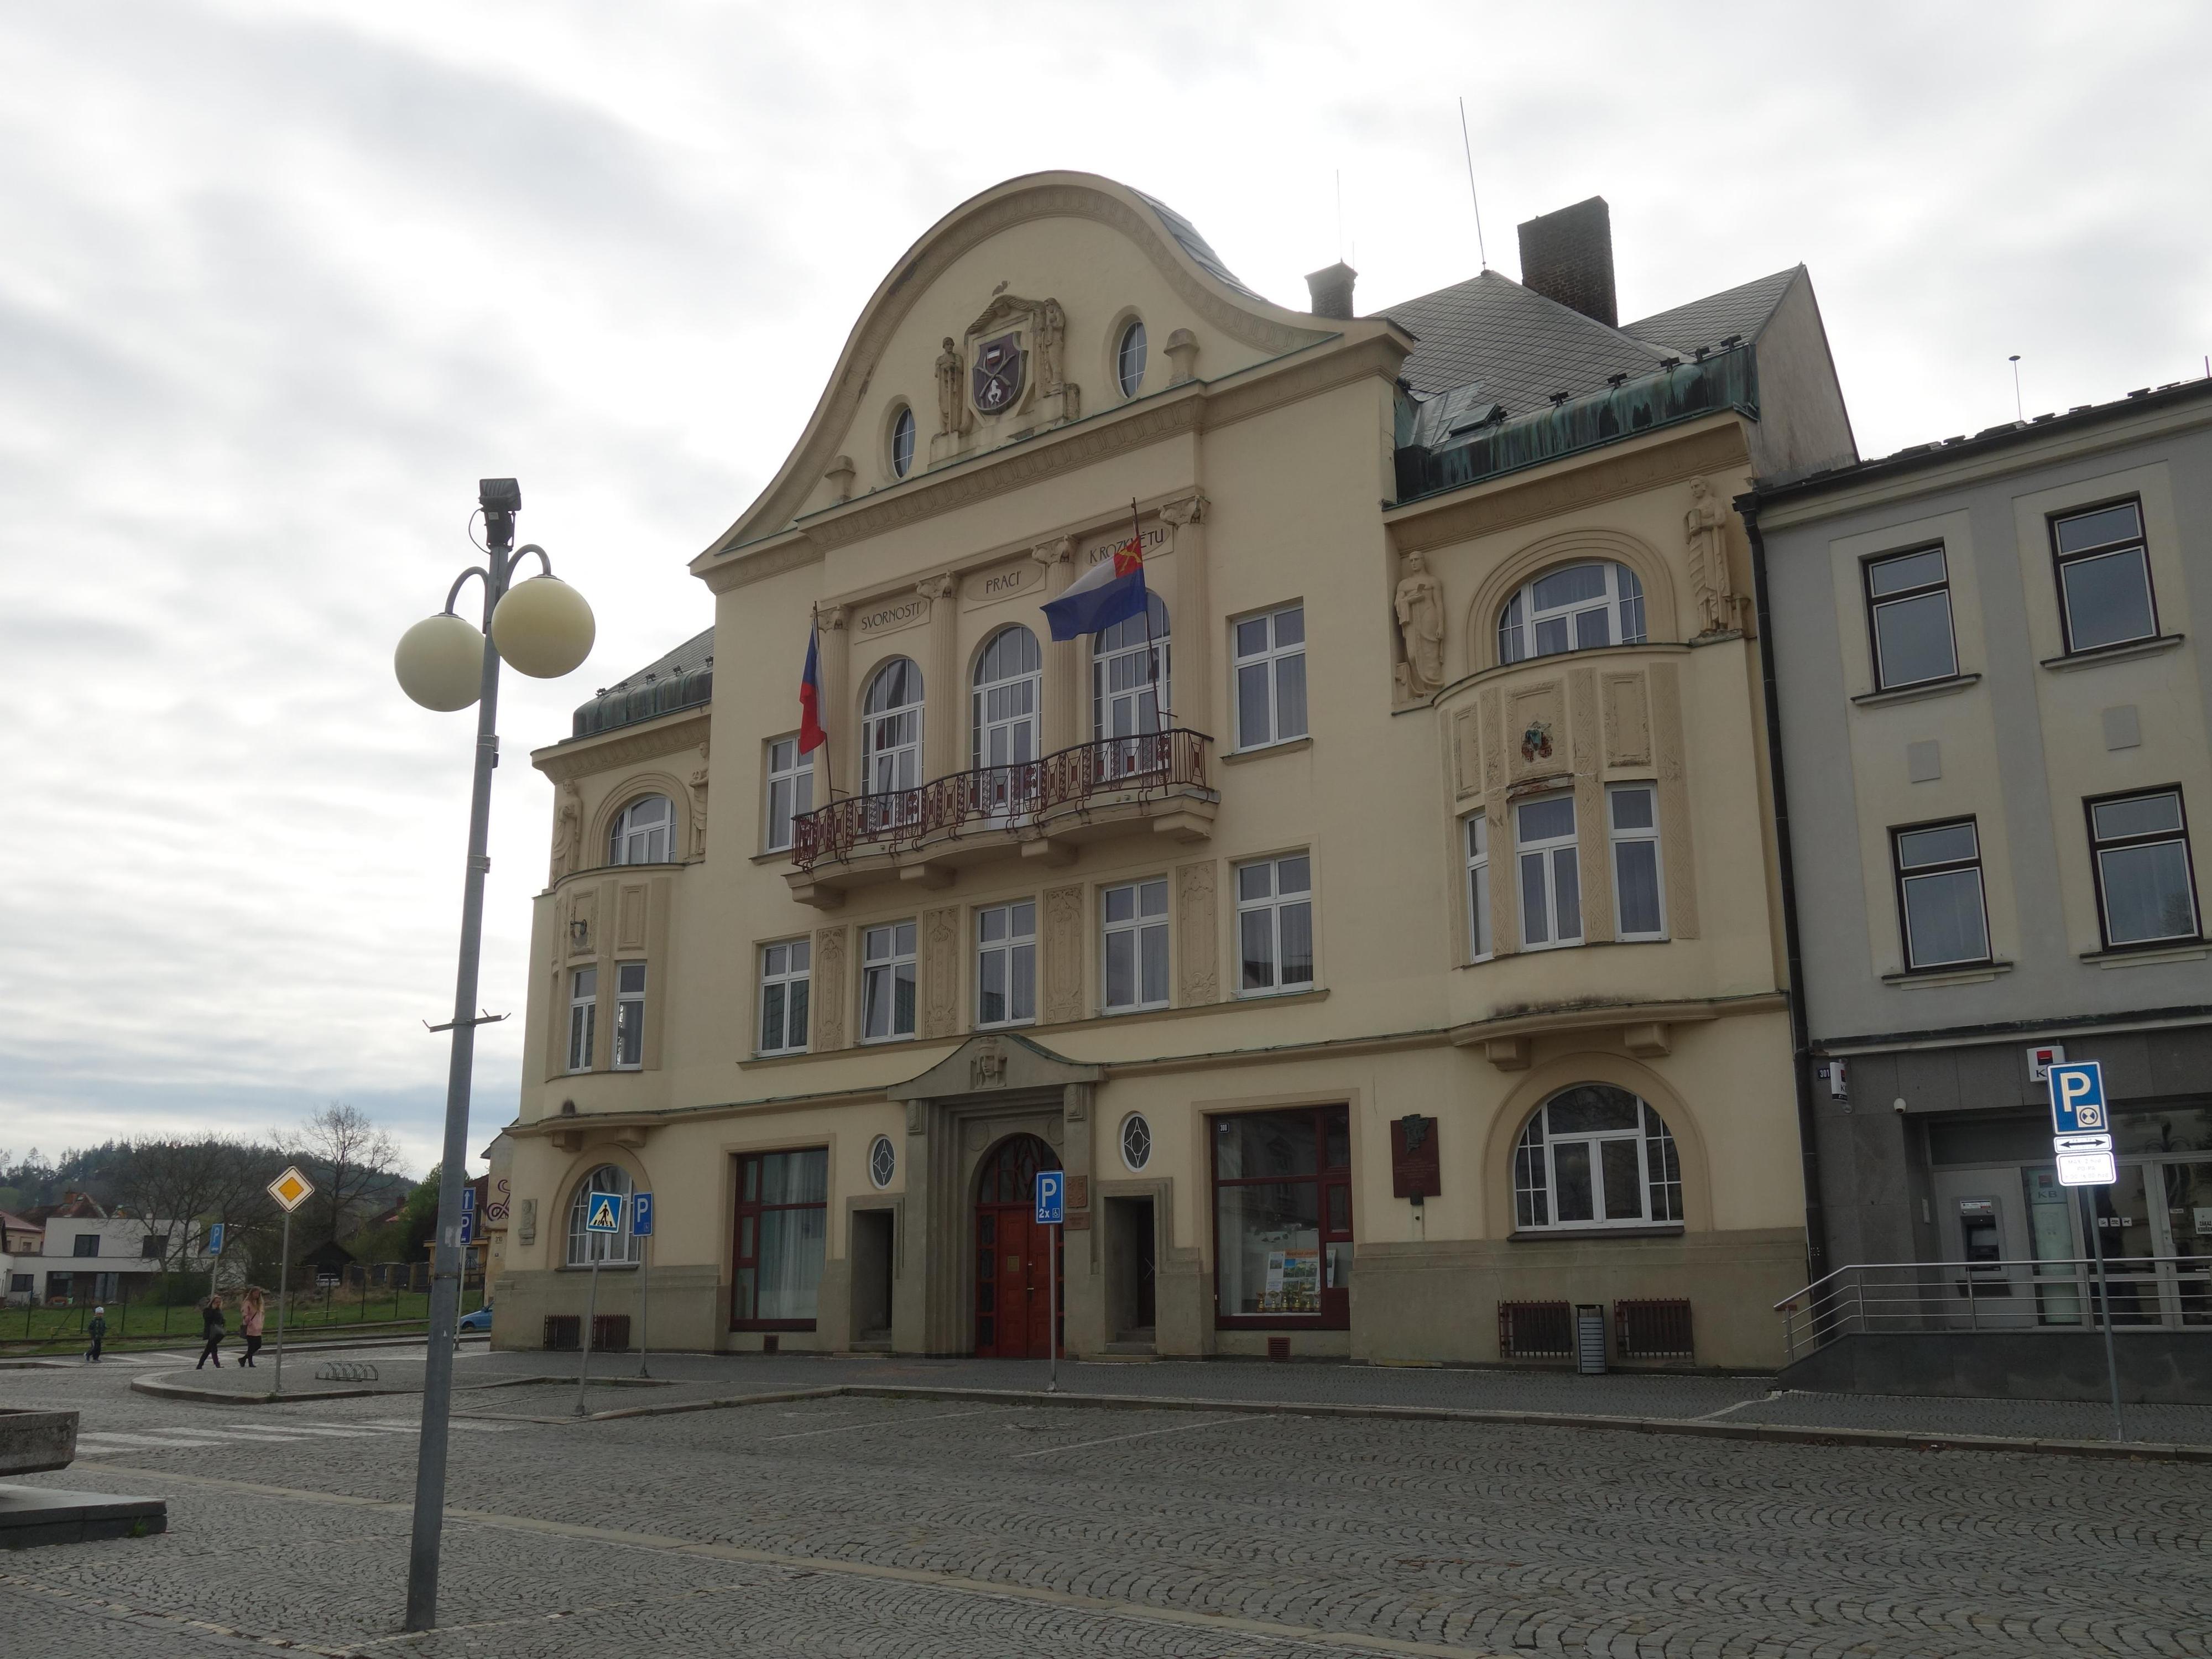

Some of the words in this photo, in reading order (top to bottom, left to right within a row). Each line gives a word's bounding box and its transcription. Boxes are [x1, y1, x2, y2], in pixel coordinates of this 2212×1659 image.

[1090, 548, 1098, 564] K
[986, 570, 1022, 594] PRACÍ
[861, 601, 921, 630] SVORNOSTÍ
[1819, 1069, 1830, 1078] 301
[2036, 1068, 2047, 1078] K
[2059, 1071, 2091, 1112] P
[1042, 1178, 1057, 1207] P
[2038, 1191, 2058, 1199] KB
[637, 1198, 649, 1223] P
[1039, 1208, 1050, 1218] 2x
[213, 1227, 220, 1243] P
